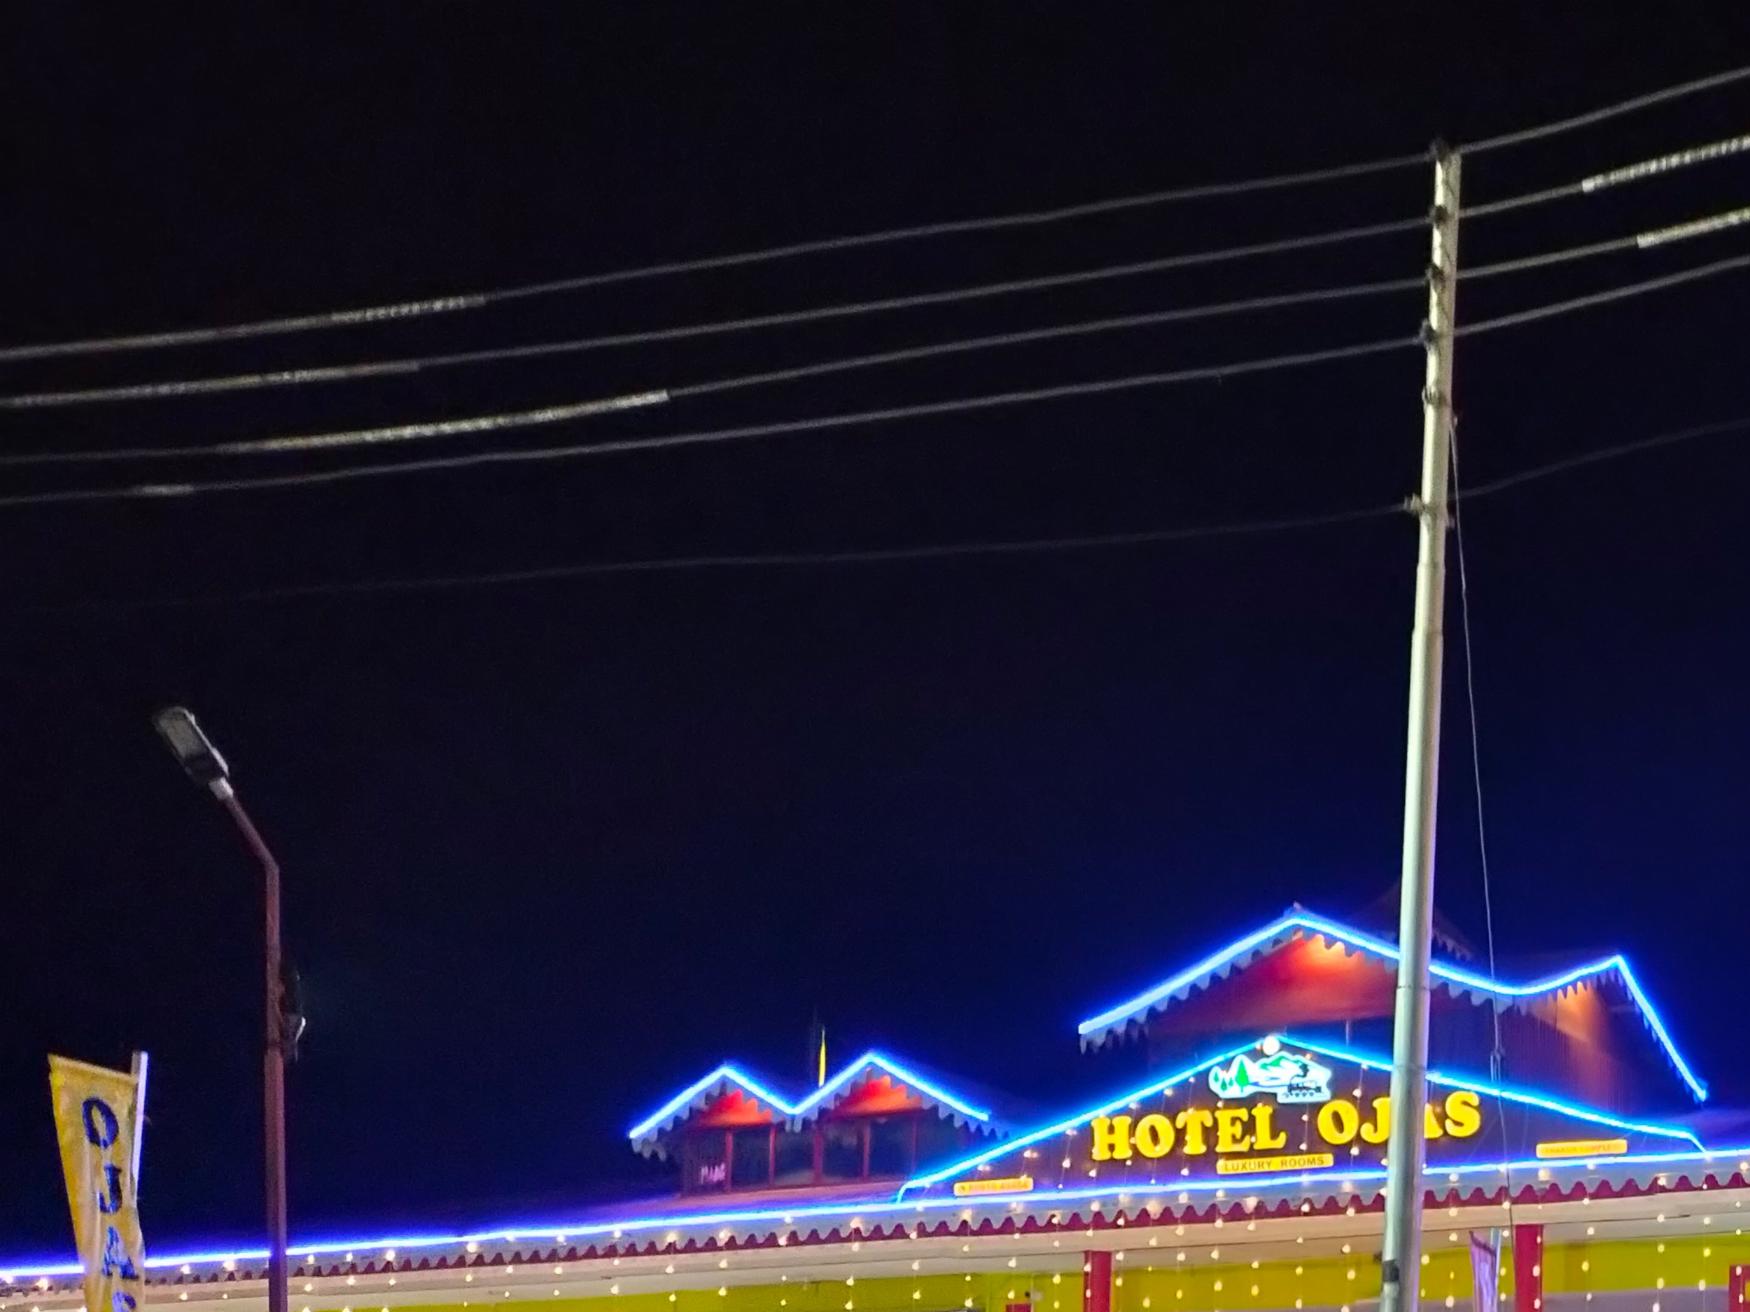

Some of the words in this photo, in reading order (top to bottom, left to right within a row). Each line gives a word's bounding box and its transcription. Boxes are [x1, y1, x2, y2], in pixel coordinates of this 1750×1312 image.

[1091, 1103, 1287, 1161] HOTEL
[1224, 1159, 1272, 1172] LUXURY
[1280, 1156, 1325, 1168] ROOMS
